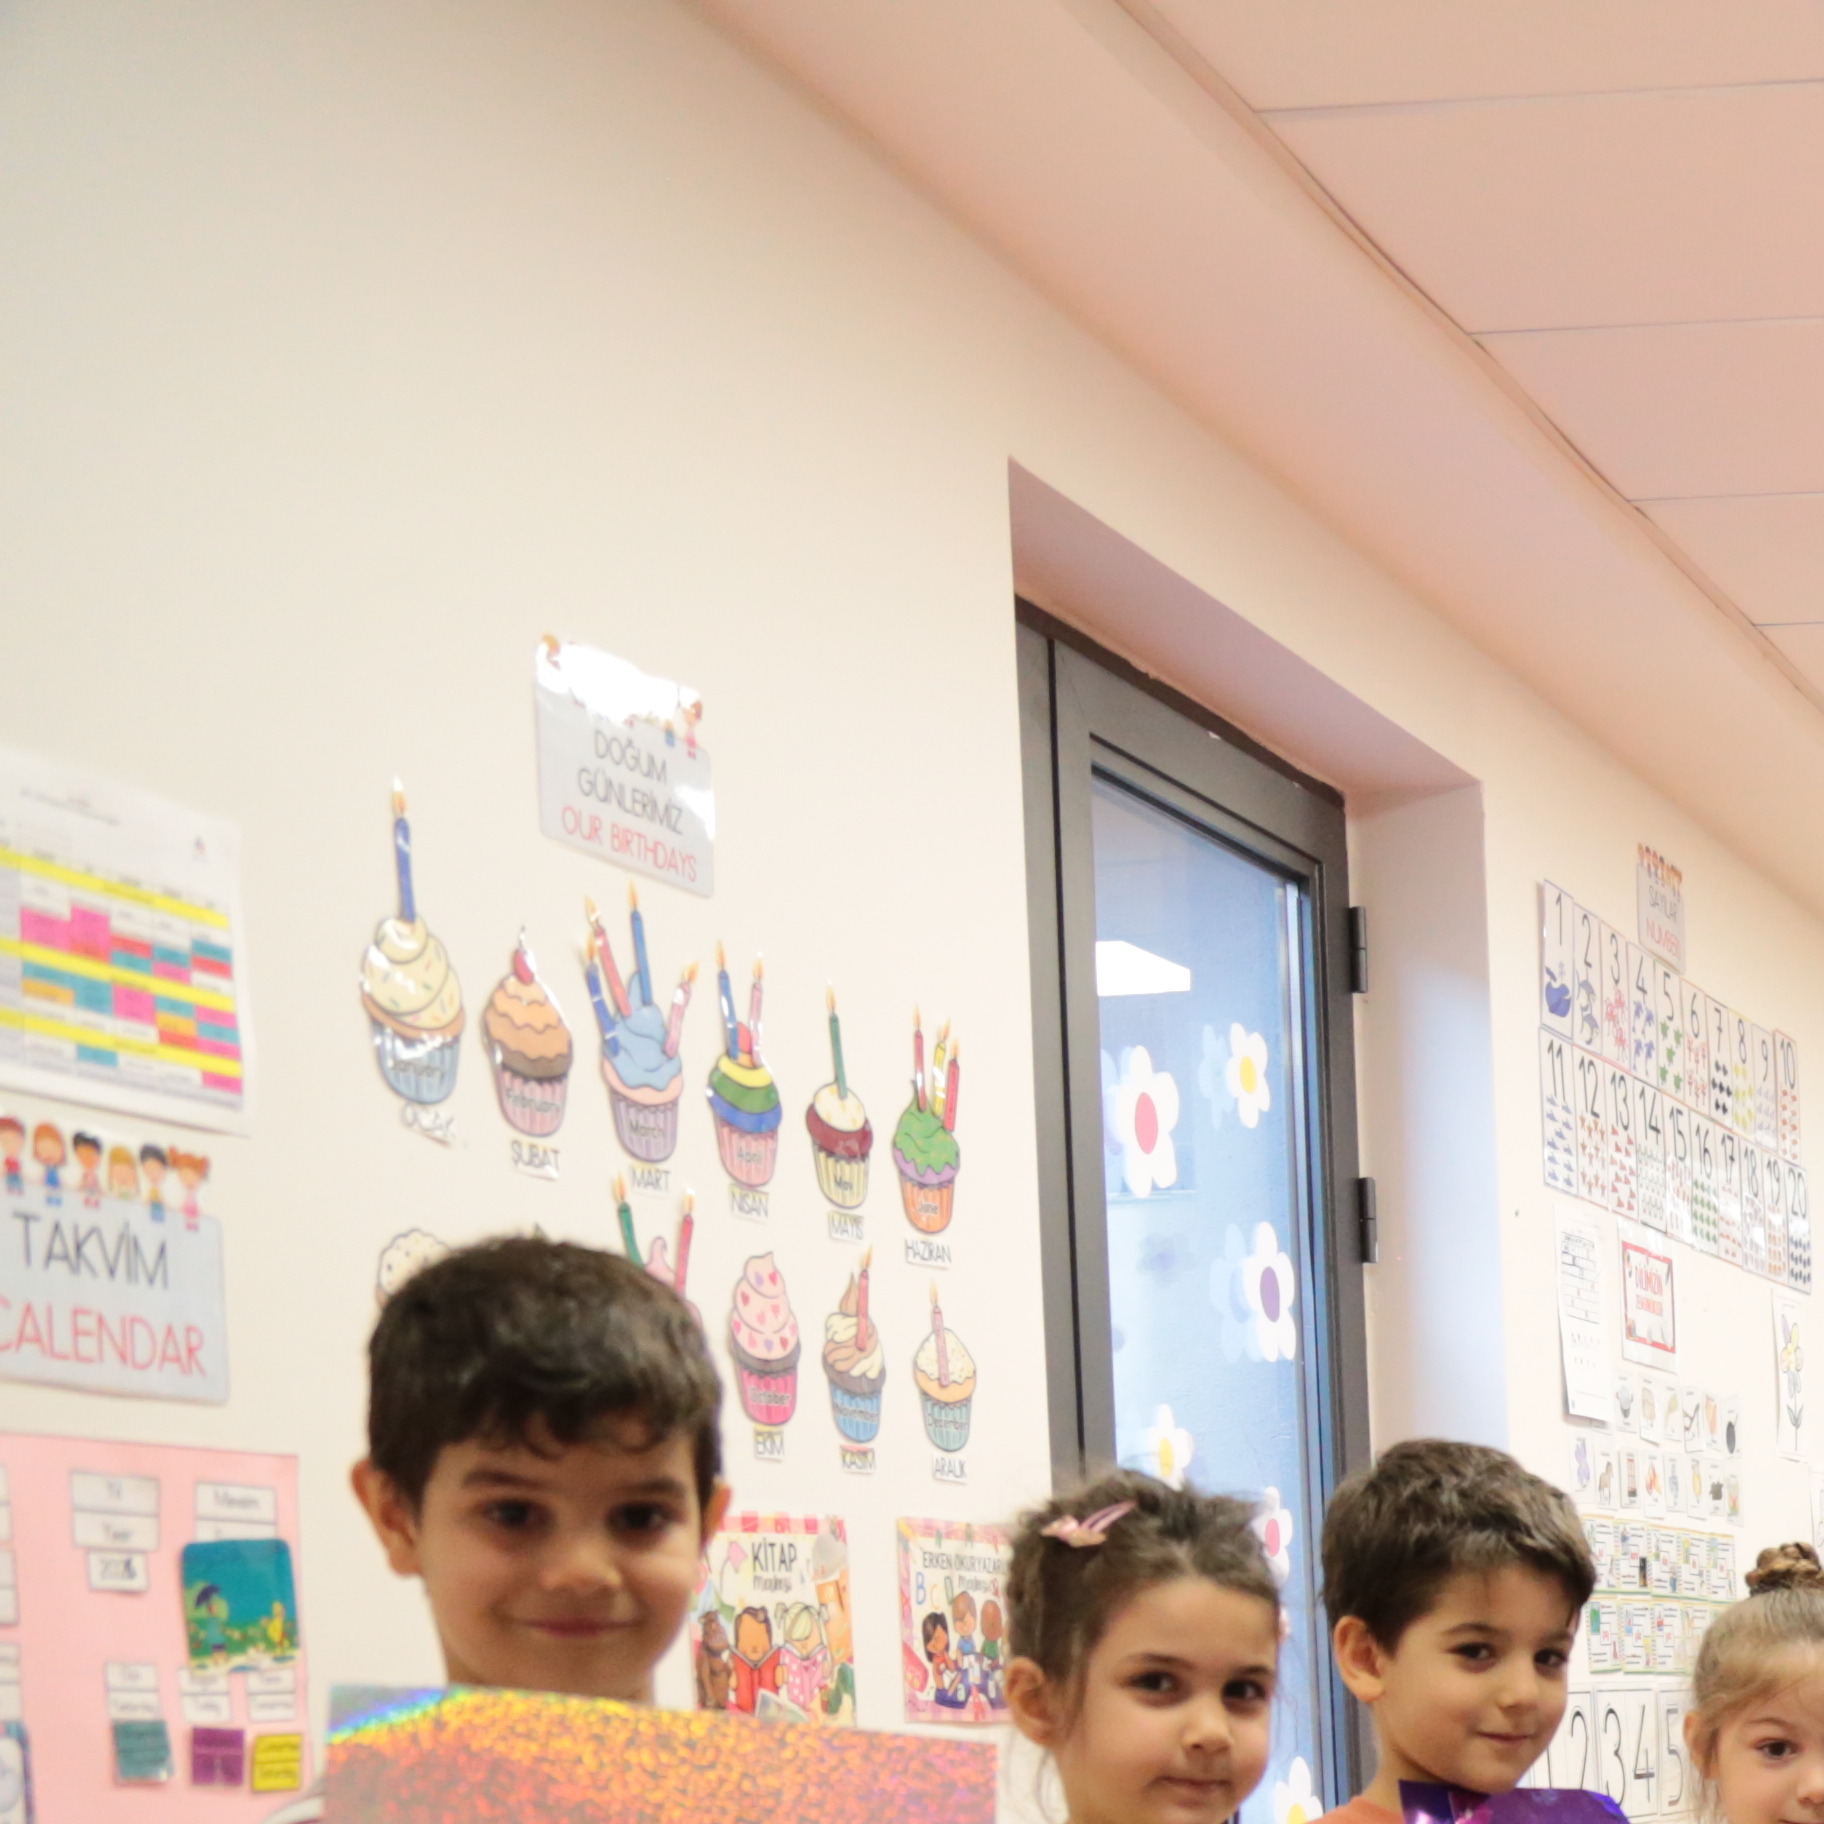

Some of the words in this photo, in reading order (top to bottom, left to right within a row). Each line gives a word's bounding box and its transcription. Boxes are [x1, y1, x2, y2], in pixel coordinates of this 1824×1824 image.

[594, 729, 667, 784] DOĞUM
[577, 767, 683, 836] GÜNLERİMİZ
[561, 805, 603, 845] OUR
[611, 822, 697, 882] BIRTHDAYS
[1556, 891, 1564, 946] 1
[1581, 913, 1593, 968] 2
[1609, 933, 1621, 985] 3
[1635, 955, 1648, 1004] 4
[1663, 971, 1674, 1022] 5
[1690, 992, 1700, 1038] 6
[1714, 1007, 1724, 1053] 7
[1737, 1018, 1747, 1065] 8
[1547, 1038, 1567, 1103] 11
[1578, 1055, 1600, 1119] 12
[1761, 1039, 1769, 1082] 9
[1780, 1038, 1796, 1090] 10
[1610, 1070, 1630, 1131] 13
[1639, 1086, 1661, 1146] 14
[1669, 1105, 1687, 1163] 15
[1695, 1123, 1713, 1180] 16
[1721, 1132, 1735, 1185] 17
[632, 1168, 671, 1192] MART
[1744, 1145, 1759, 1199] 18
[1766, 1156, 1781, 1207] 19
[1788, 1166, 1807, 1220] 20
[12, 1211, 169, 1290] TAKVİM
[751, 1537, 798, 1574] KİTAP
[922, 1551, 952, 1570] ERKEN
[1604, 1703, 1626, 1808] 3
[1633, 1704, 1656, 1803] 4
[1666, 1703, 1684, 1808] 5
